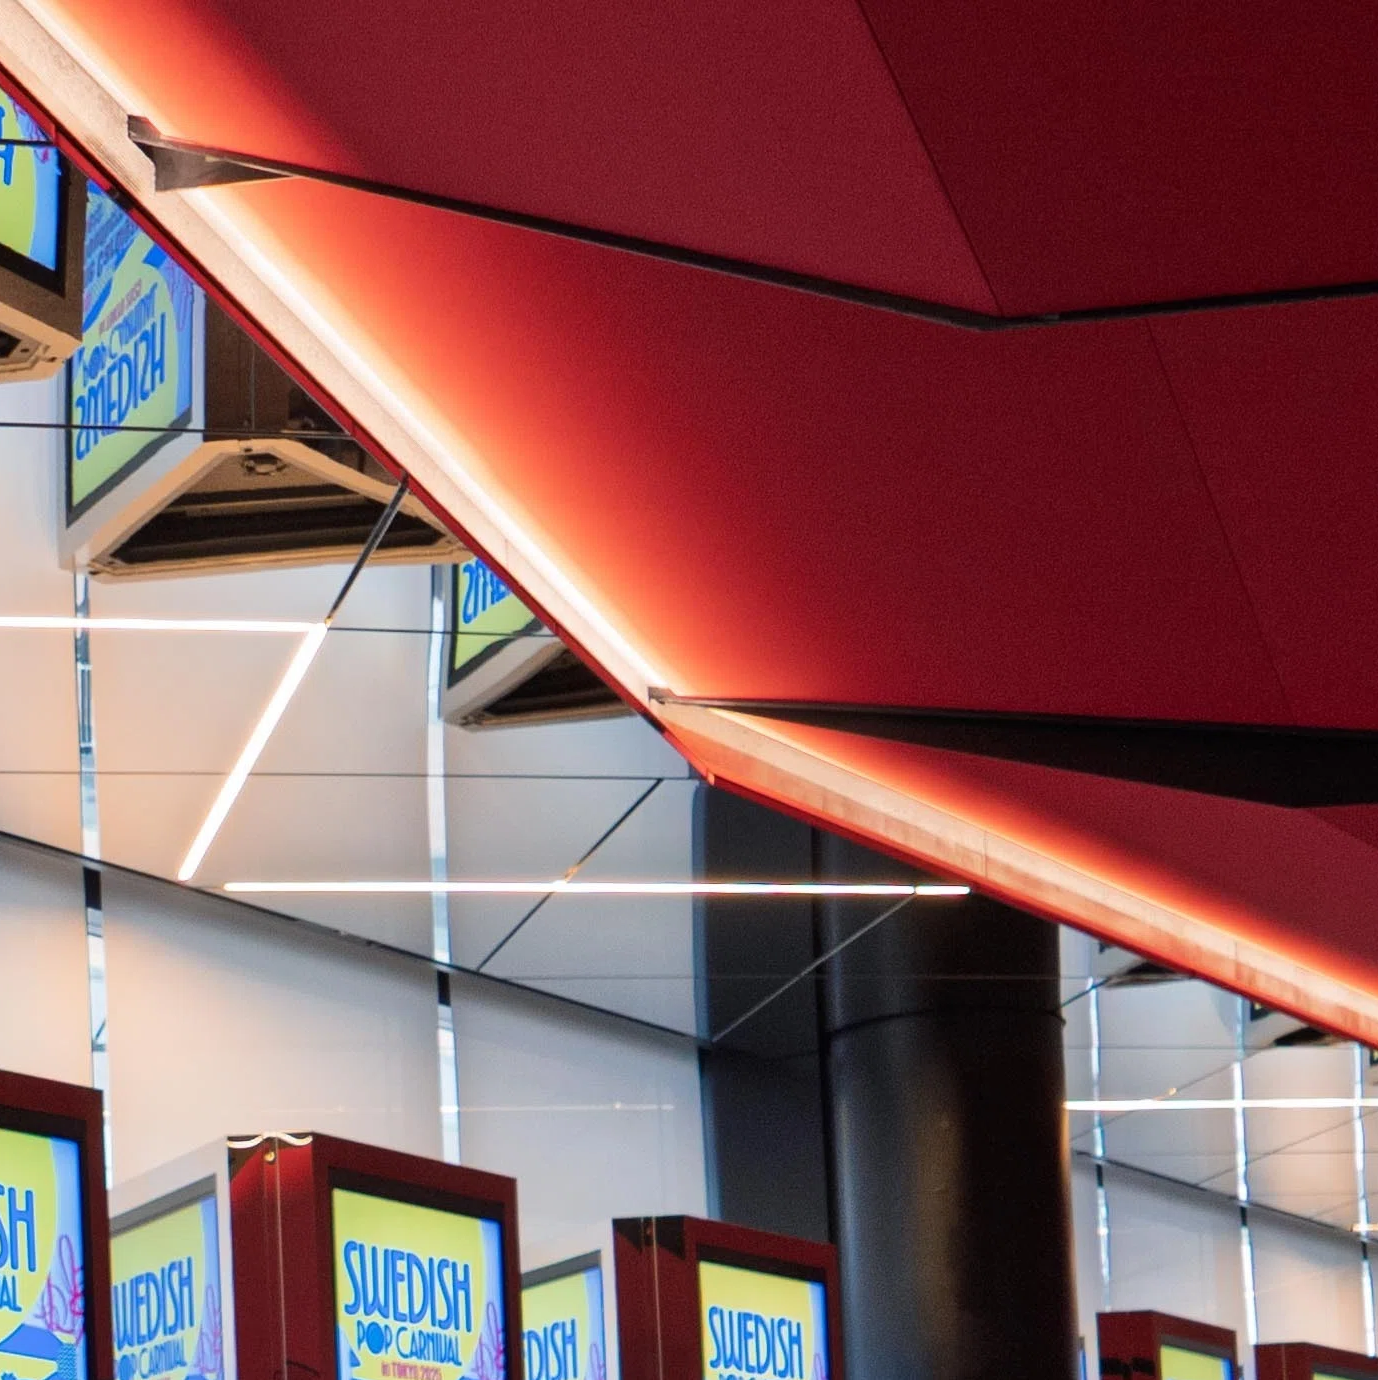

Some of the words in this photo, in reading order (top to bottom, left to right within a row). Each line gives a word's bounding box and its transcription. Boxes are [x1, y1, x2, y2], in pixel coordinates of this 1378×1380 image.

[112, 1256, 194, 1352] WEDISH
[344, 1240, 472, 1333] SWEDISH
[357, 1319, 393, 1355] POP
[396, 1326, 463, 1366] CARNIVAL
[708, 1306, 803, 1380] SWEDISH
